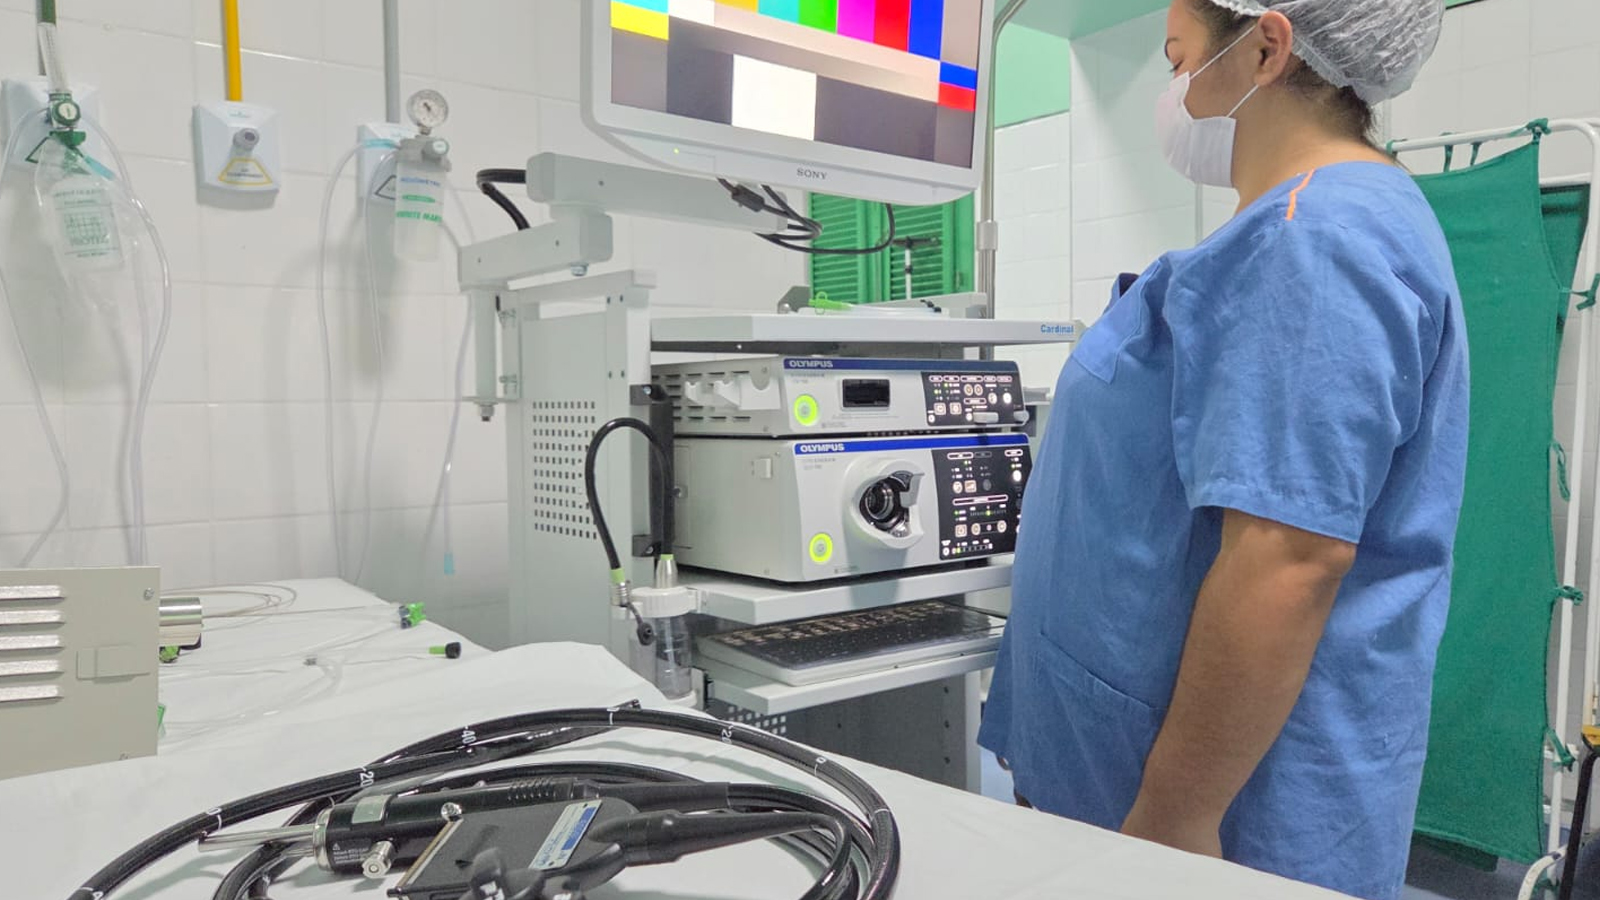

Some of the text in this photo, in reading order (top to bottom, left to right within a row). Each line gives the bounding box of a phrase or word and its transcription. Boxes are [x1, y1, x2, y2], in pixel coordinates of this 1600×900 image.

[796, 167, 828, 180] SONY
[1040, 323, 1074, 334] Cardinal
[788, 360, 834, 368] OLYMPUS
[800, 443, 845, 453] OLYMPUS
[461, 729, 477, 744] 40
[360, 770, 375, 788] 20
